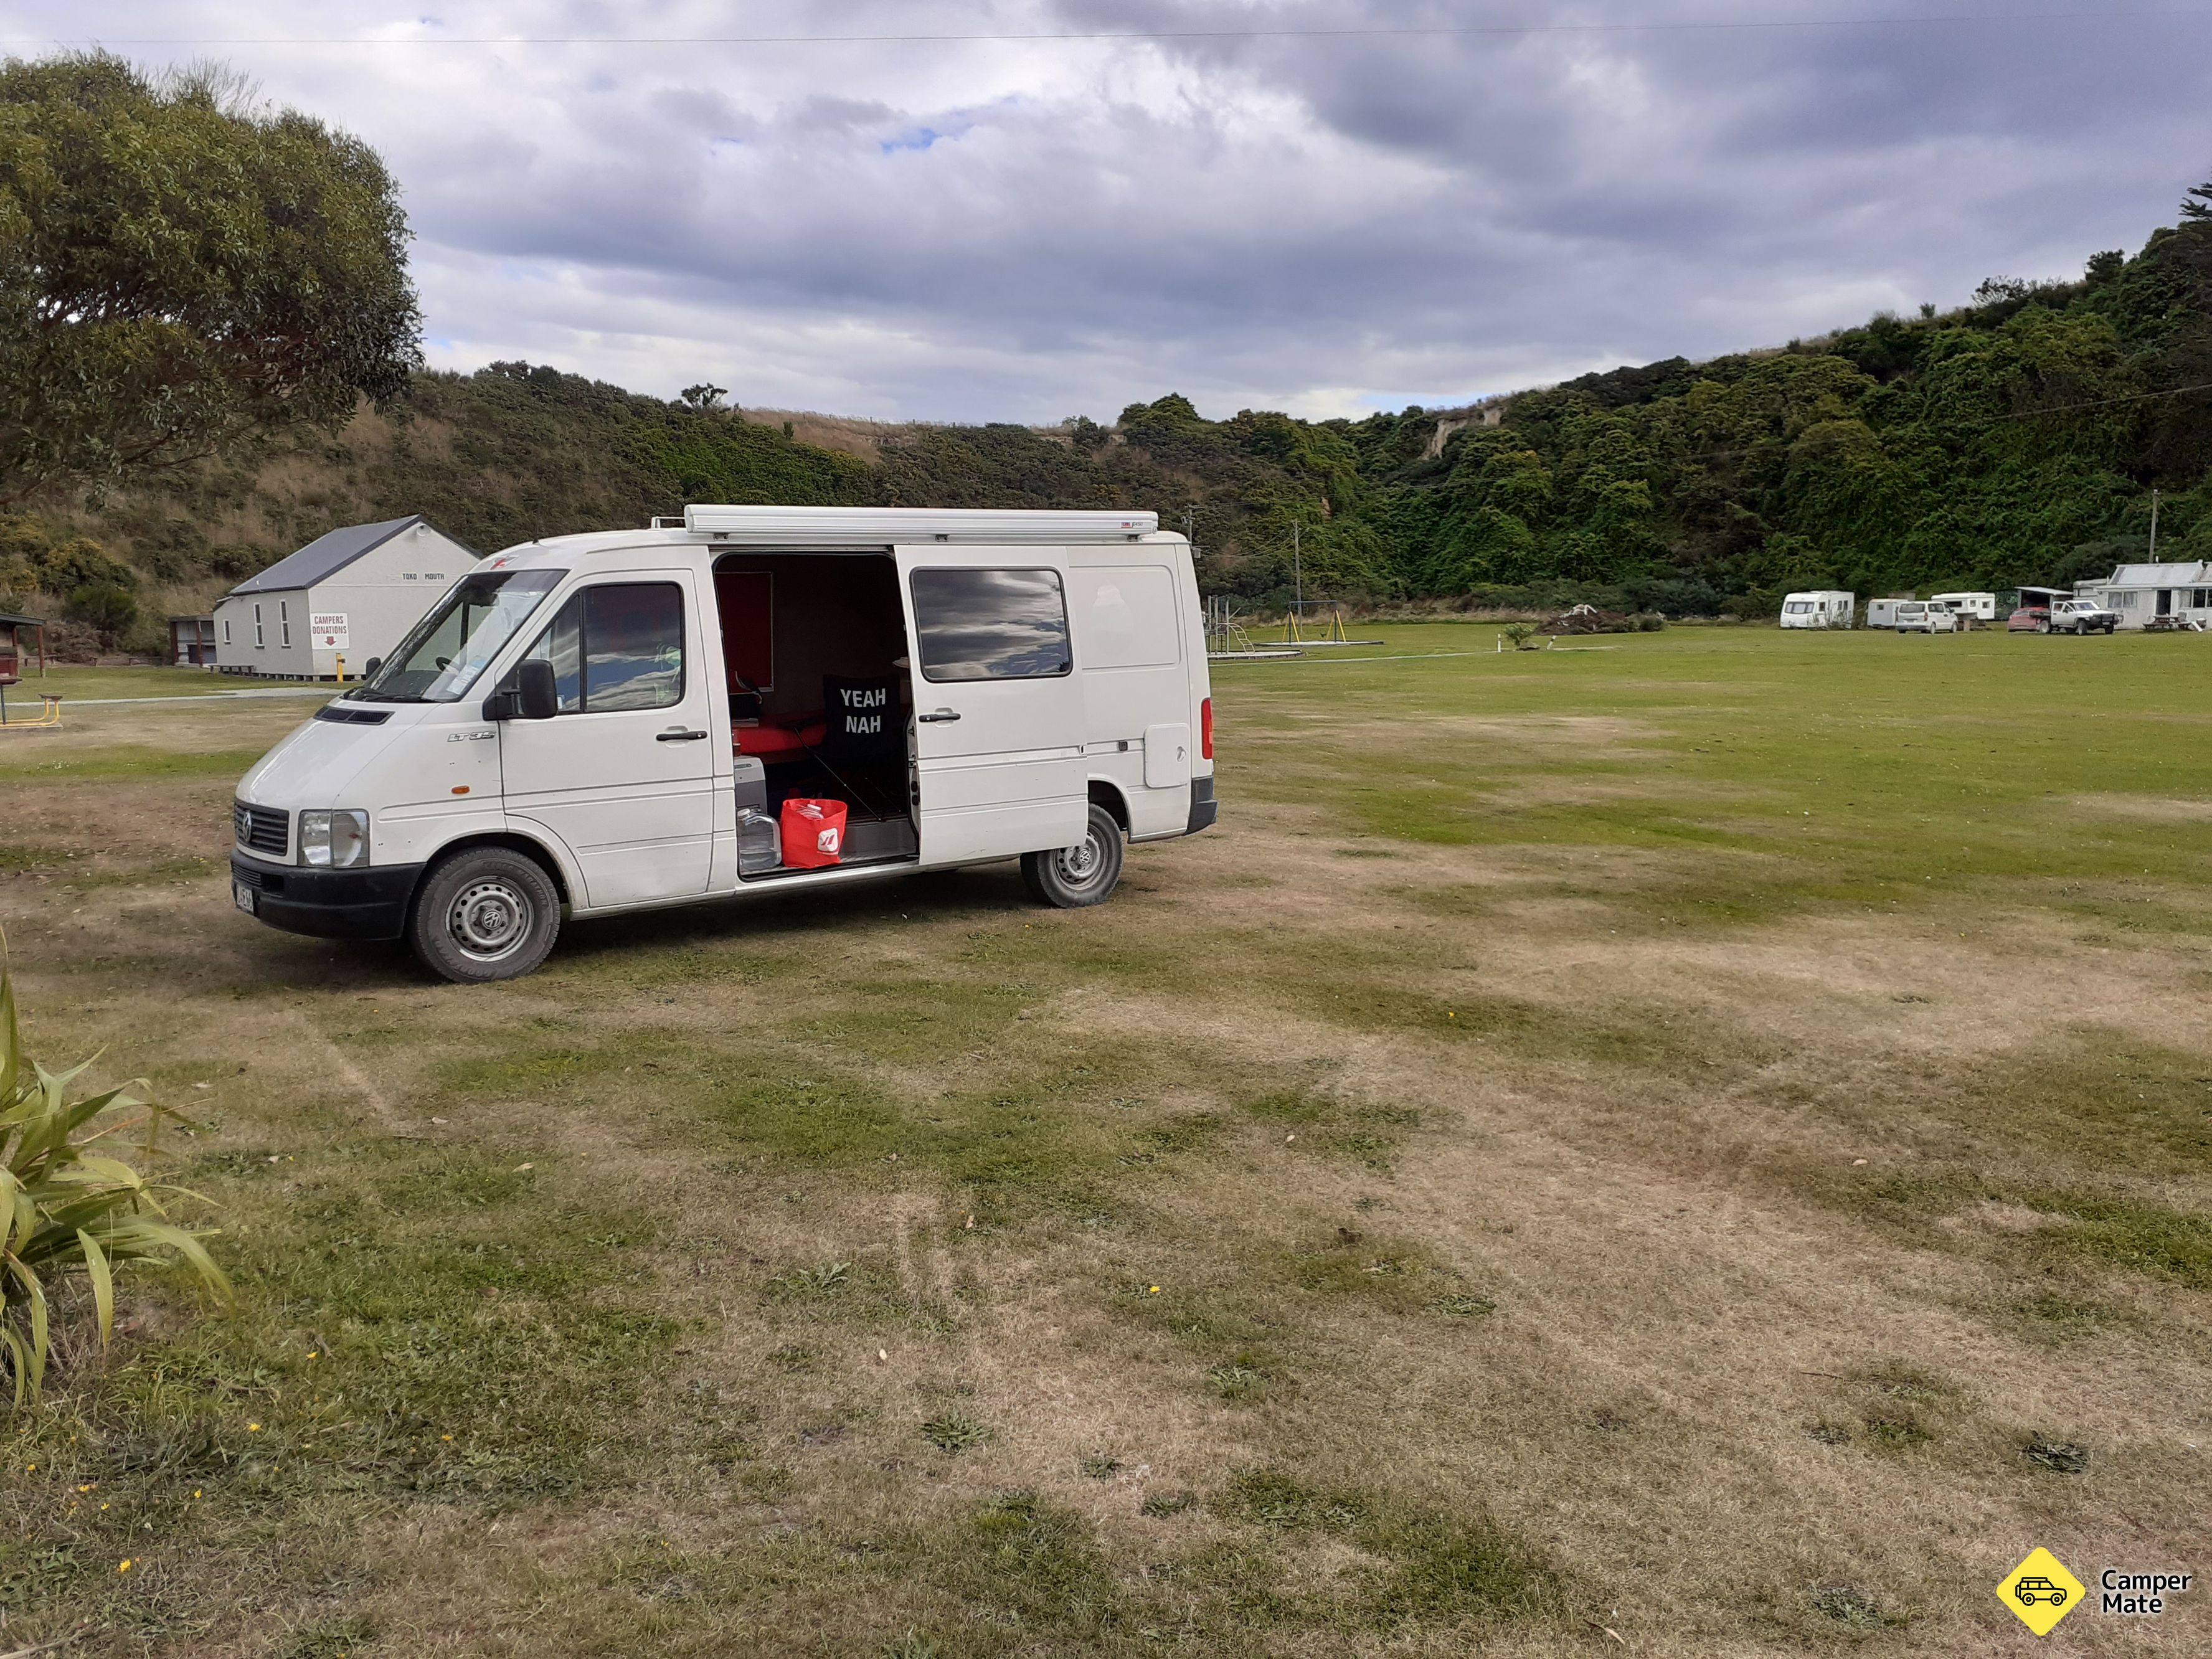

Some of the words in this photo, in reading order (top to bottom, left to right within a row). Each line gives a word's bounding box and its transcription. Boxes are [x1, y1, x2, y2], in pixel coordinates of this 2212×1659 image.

[314, 615, 344, 625] CAMPERS
[312, 625, 347, 635] DONATIONS
[839, 688, 886, 707] YEAH
[846, 715, 881, 734] NAH
